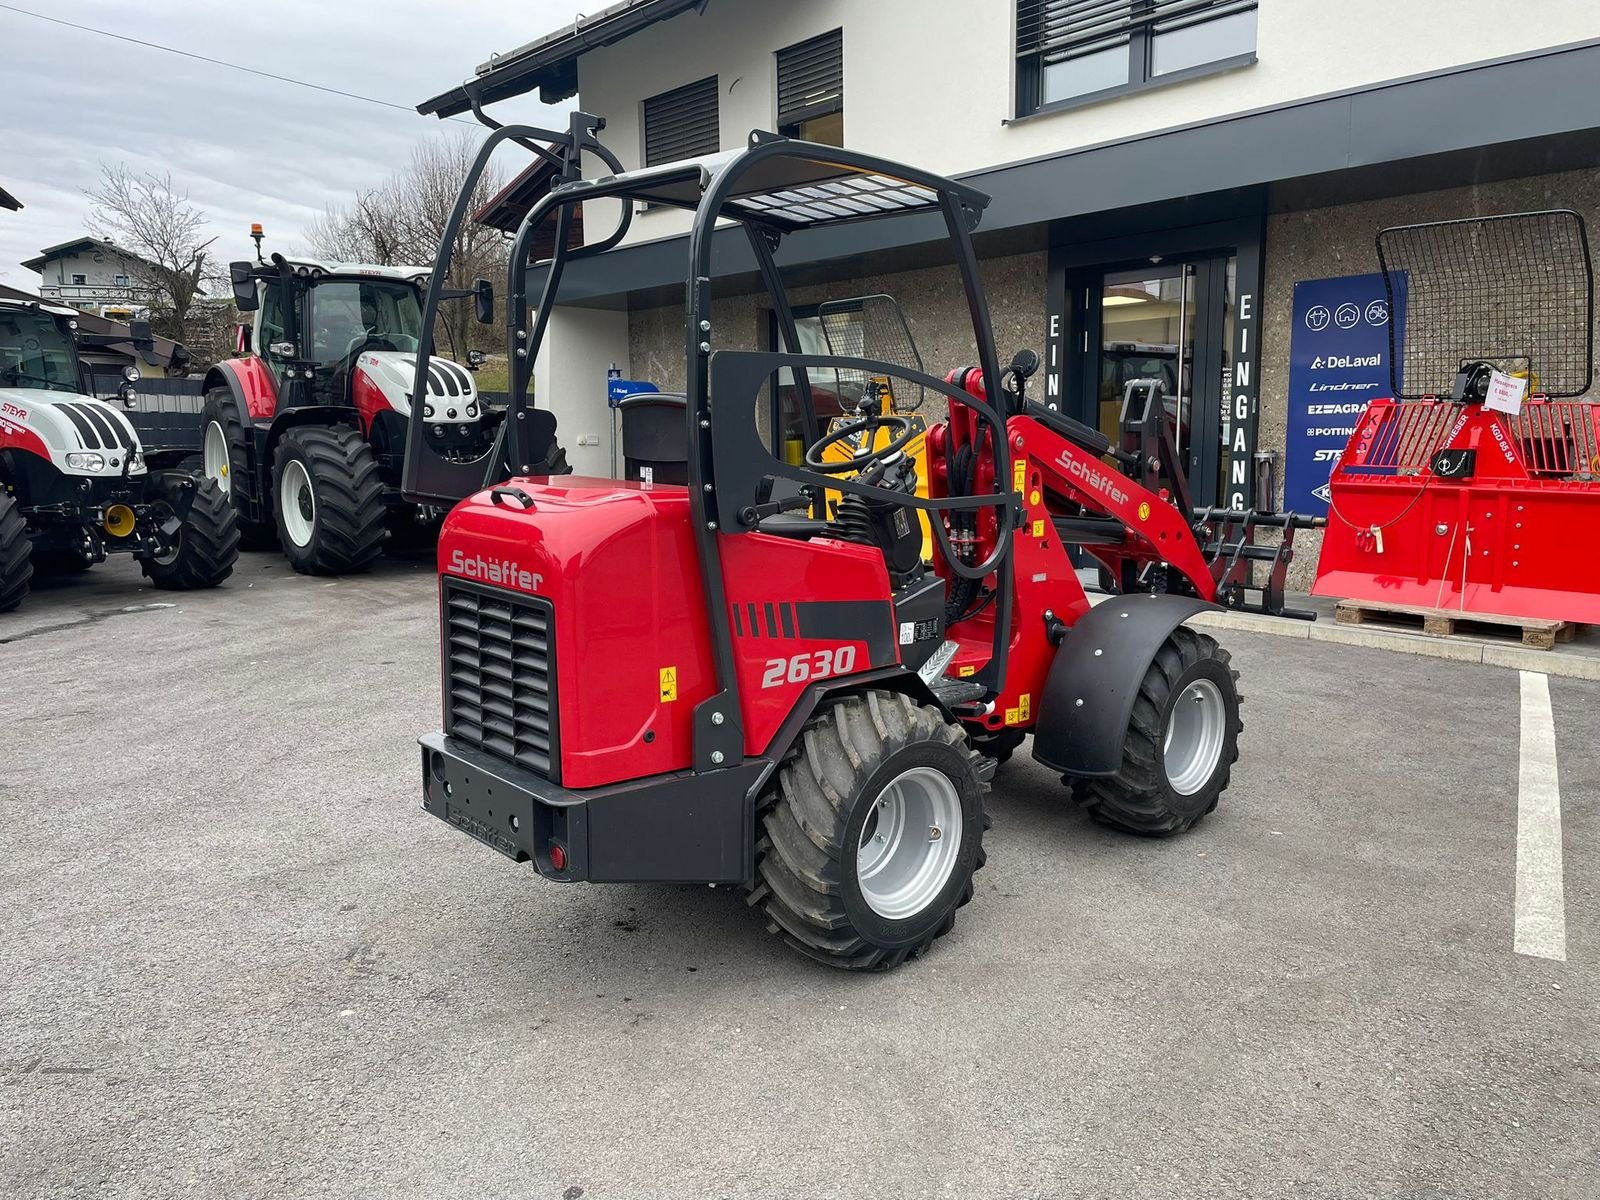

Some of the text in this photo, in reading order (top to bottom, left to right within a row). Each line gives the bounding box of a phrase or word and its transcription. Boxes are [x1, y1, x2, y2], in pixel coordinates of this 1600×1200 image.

[1327, 353, 1381, 369] DeLaval
[1231, 294, 1252, 511] EINGANG
[1309, 382, 1379, 392] Lindner
[1, 402, 27, 420] STEYR
[1490, 423, 1516, 464] KGD 65 SA
[1055, 449, 1129, 505] Schäffer
[447, 549, 544, 591] Schäffer
[762, 645, 856, 689] 2630
